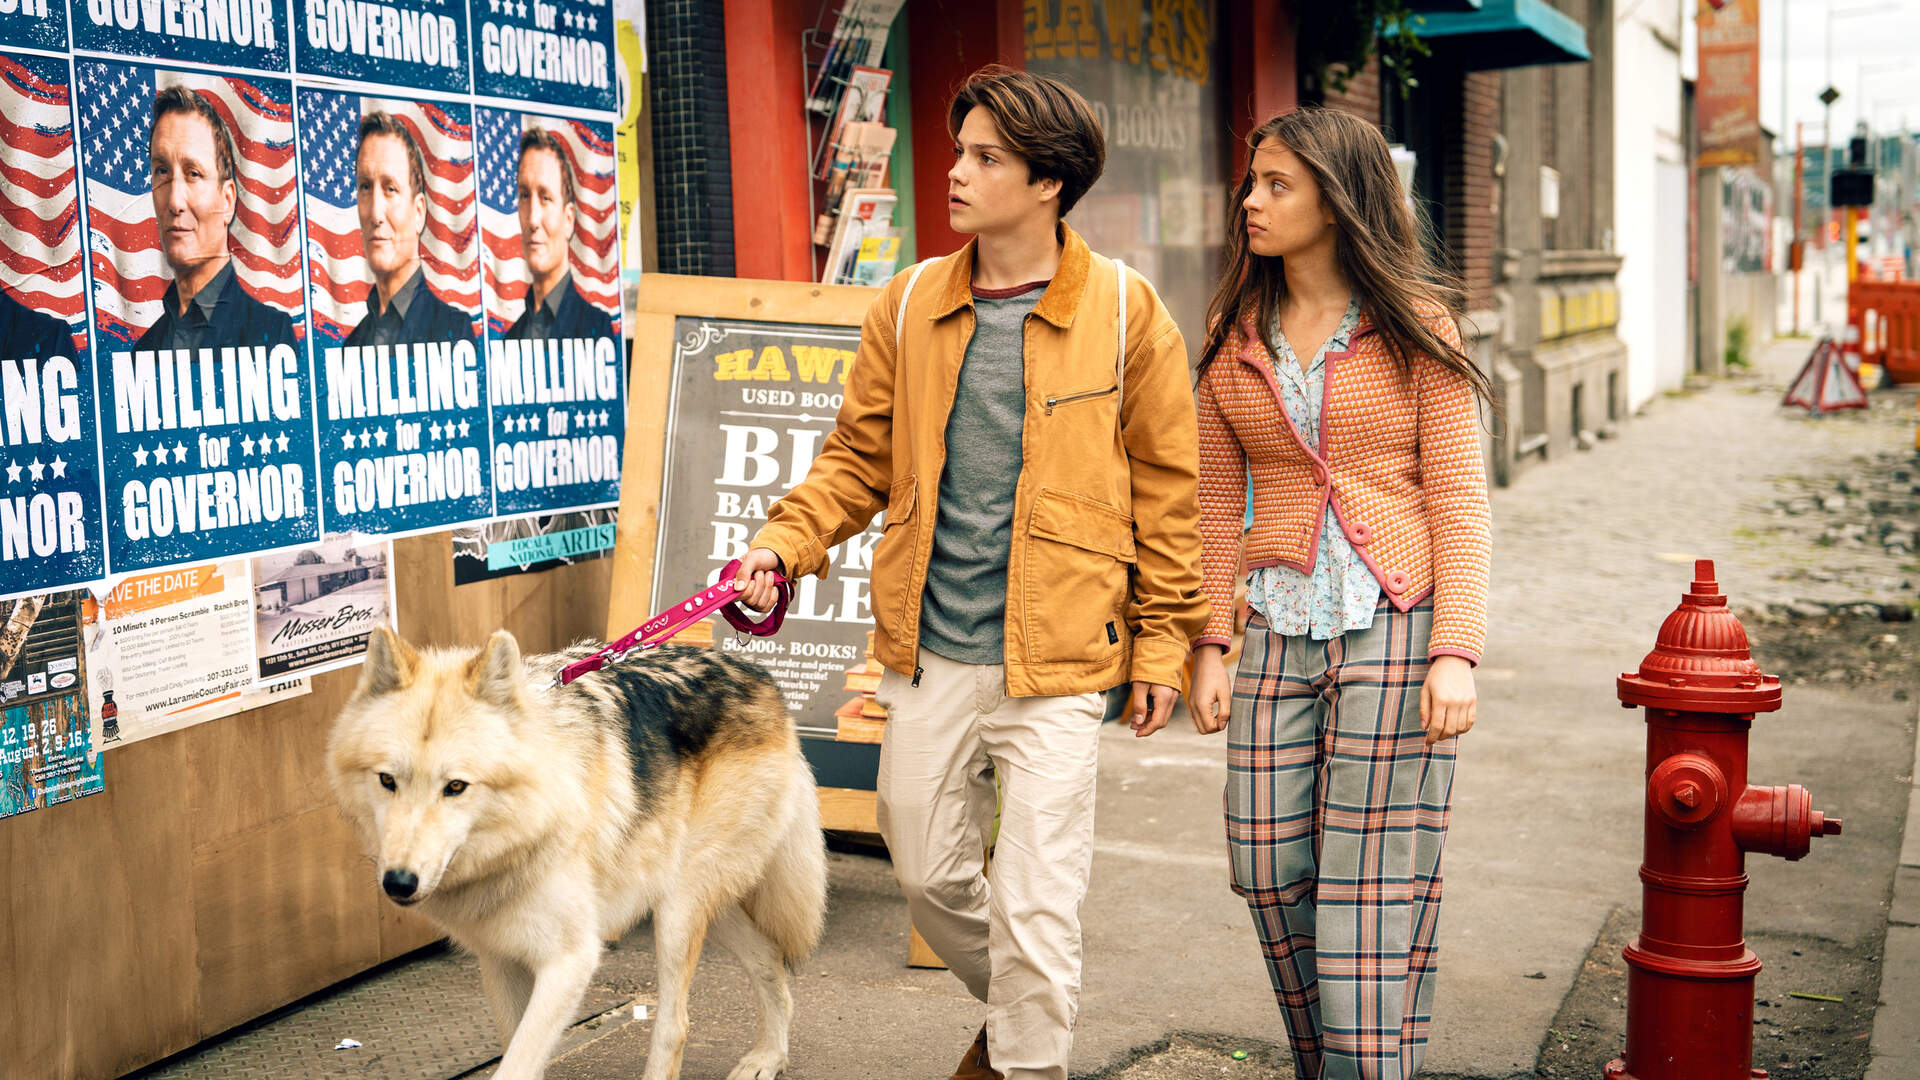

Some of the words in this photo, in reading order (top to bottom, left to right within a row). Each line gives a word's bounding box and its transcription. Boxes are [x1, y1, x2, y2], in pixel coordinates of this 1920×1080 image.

[534, 0, 557, 30] for
[305, 0, 459, 69] GOVERNOR
[482, 22, 609, 90] GOVERNOR
[1116, 102, 1188, 149] BOOKS
[111, 344, 301, 434] MILLING
[324, 339, 479, 421] MILLING
[490, 337, 617, 406] MILLING
[0, 356, 81, 446] NG
[742, 388, 795, 406] USED
[396, 419, 421, 451] for
[547, 407, 568, 436] for
[199, 433, 230, 468] for
[495, 435, 619, 493] GOVERNOR
[333, 447, 482, 516] GOVERNOR
[122, 463, 305, 541] GOVERNOR
[104, 582, 133, 604] AVE
[136, 576, 162, 598] THE
[164, 569, 199, 593] DATE
[112, 626, 122, 635] 10
[122, 622, 147, 633] Minute
[149, 616, 155, 626] 4
[155, 614, 179, 626] Person
[179, 607, 210, 620] Scramble
[213, 602, 234, 612] Ranch
[272, 614, 336, 644] Musser
[722, 637, 786, 655] 50,000+
[790, 641, 857, 660] BOOKS!
[801, 660, 817, 669] and
[819, 661, 845, 672] prices
[790, 670, 799, 679] to
[809, 681, 820, 693] by
[22, 723, 39, 741] 19,
[41, 718, 57, 737] 26
[0, 741, 40, 765] August
[68, 730, 85, 749] 16,
